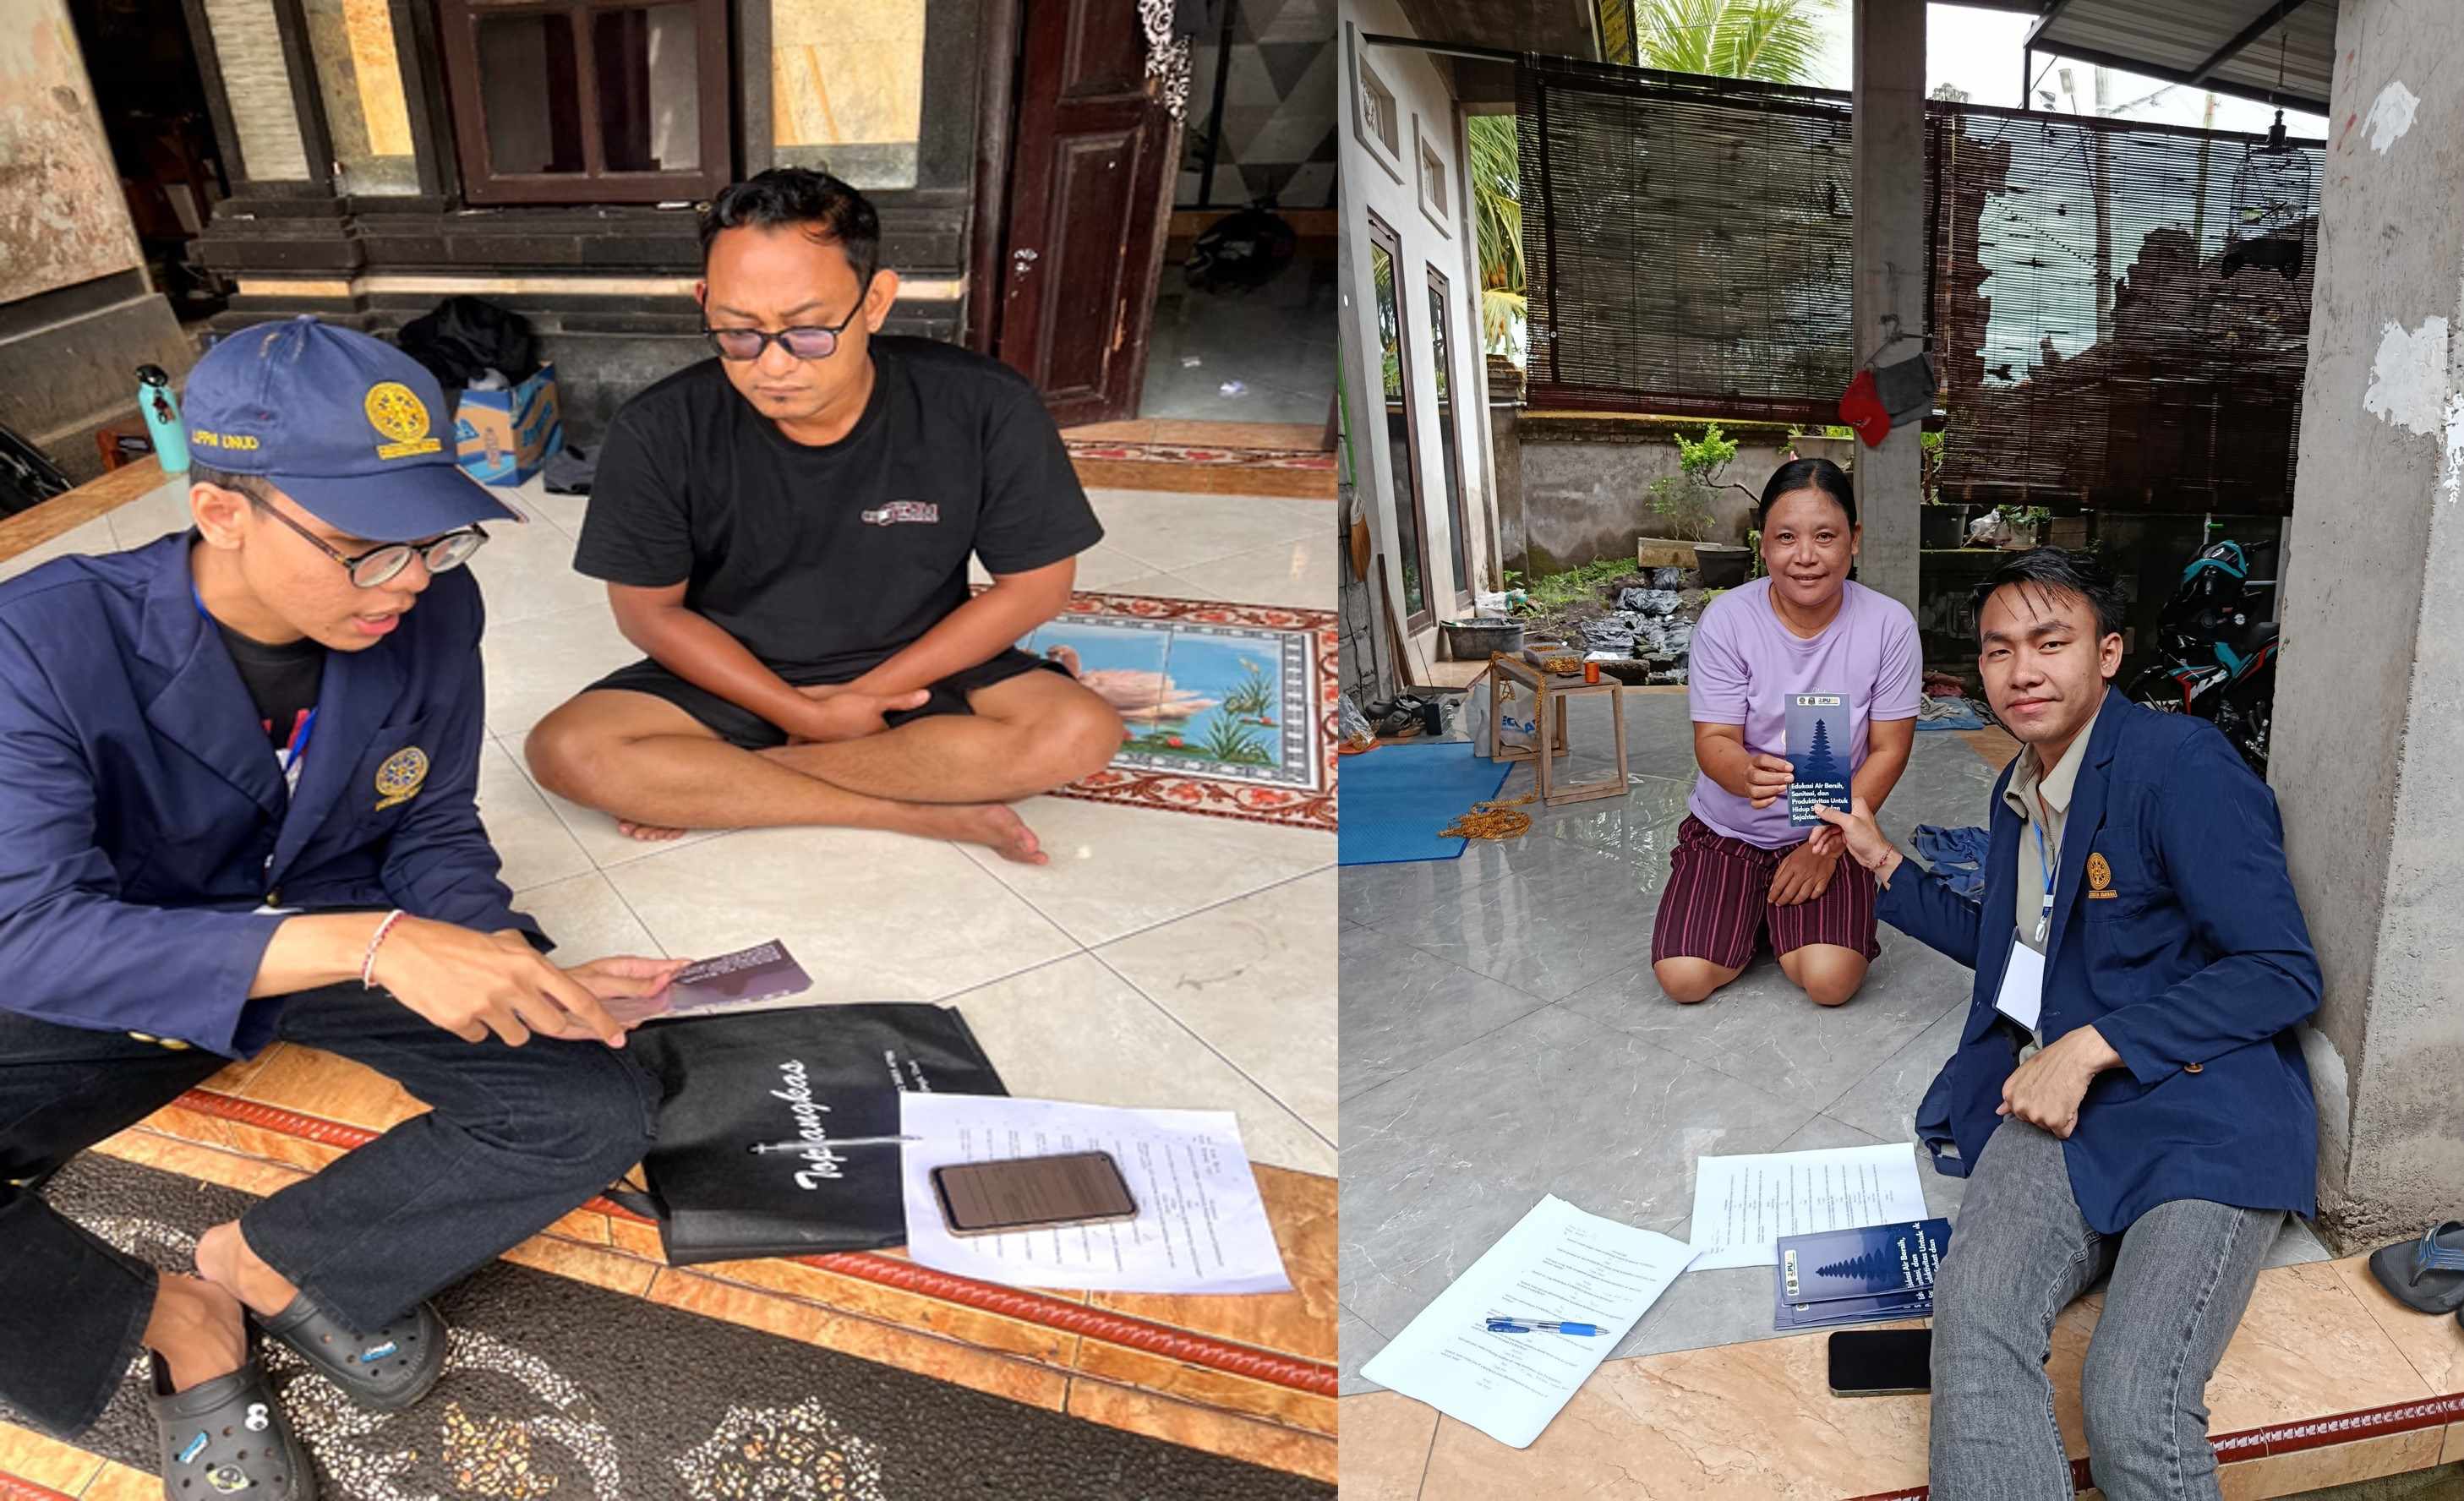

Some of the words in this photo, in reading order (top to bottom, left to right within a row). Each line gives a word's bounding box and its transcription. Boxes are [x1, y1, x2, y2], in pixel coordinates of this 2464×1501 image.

[1897, 1236, 1908, 1261] Bersih,
[1915, 1230, 1926, 1252] Untuk
[1928, 1238, 1937, 1253] dan
